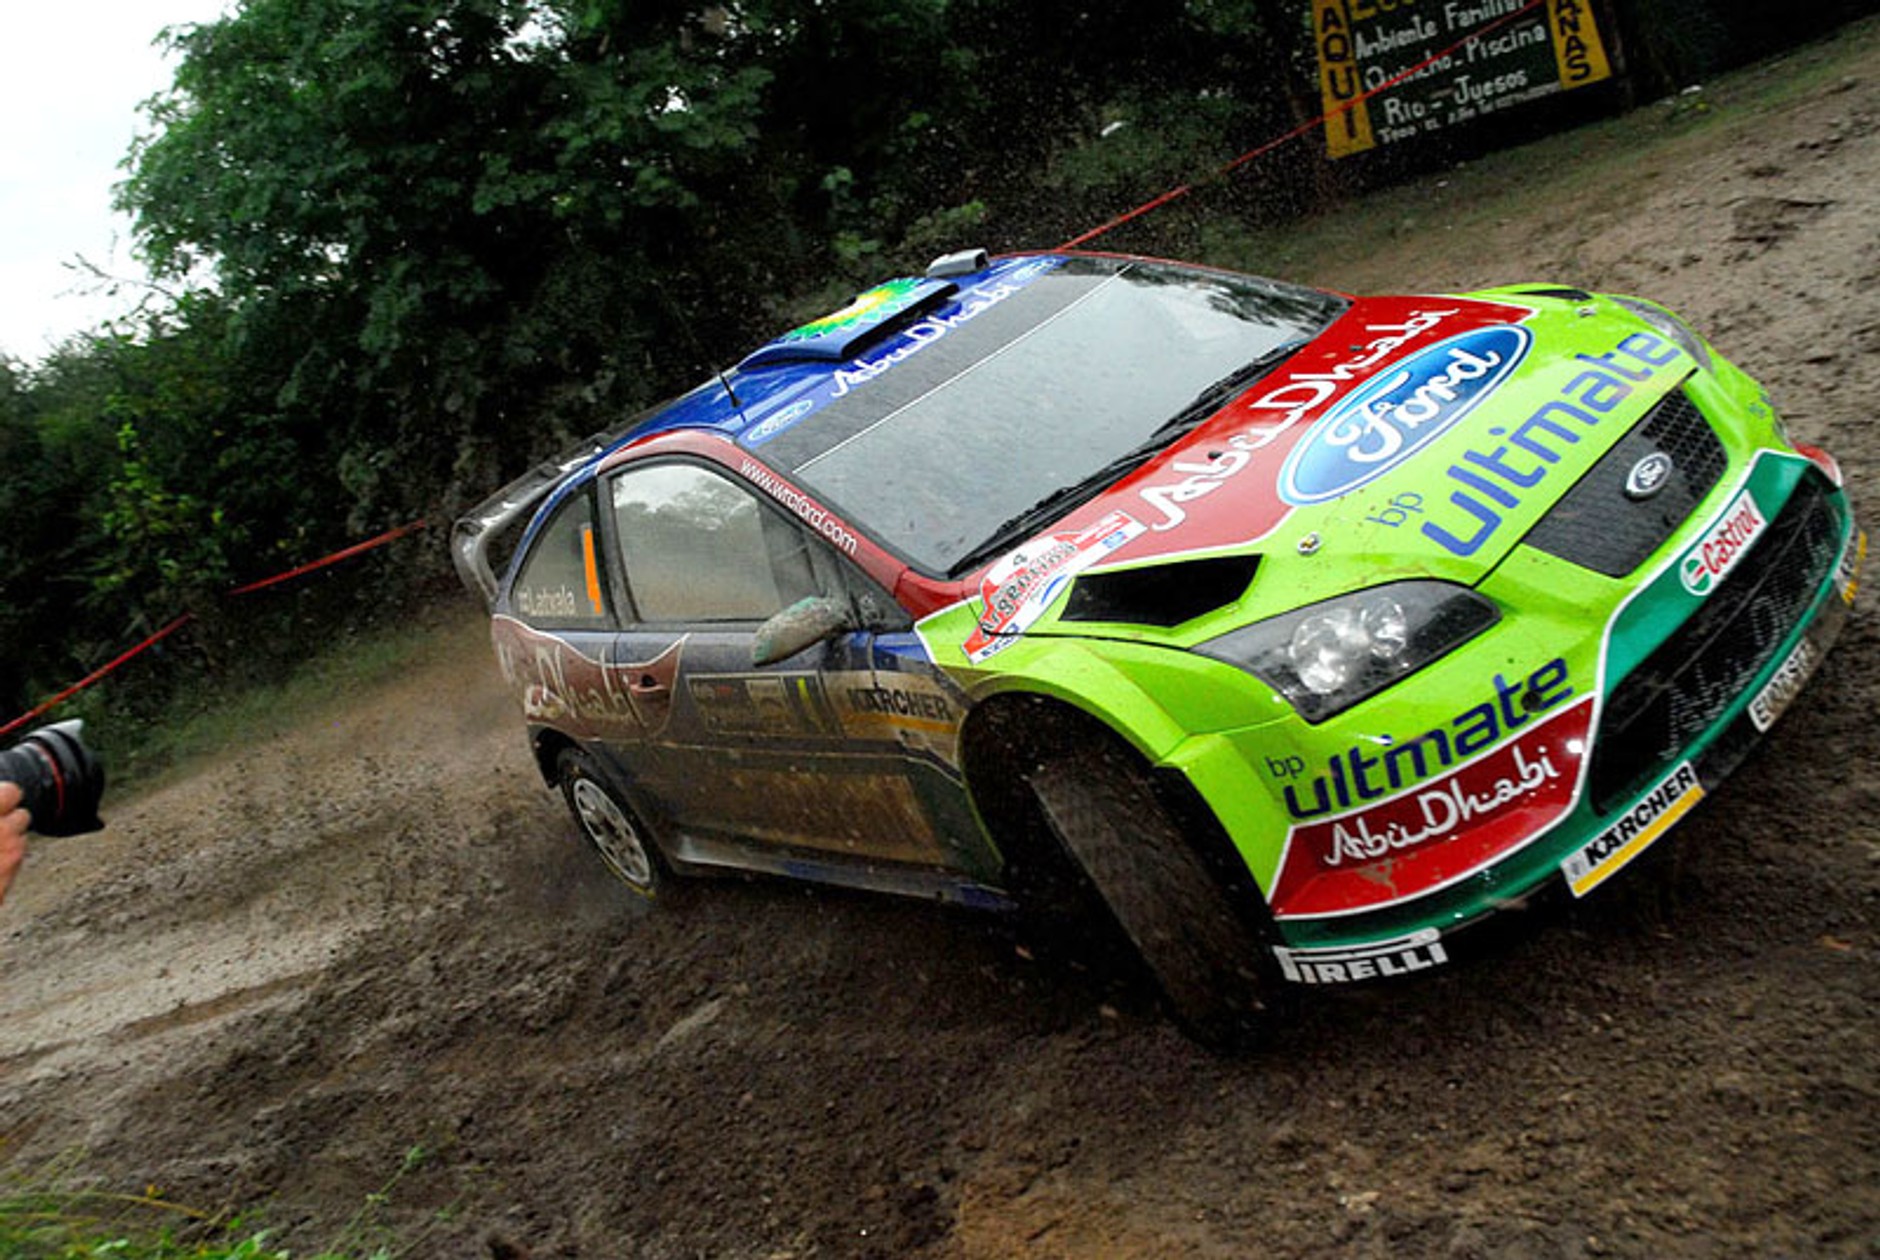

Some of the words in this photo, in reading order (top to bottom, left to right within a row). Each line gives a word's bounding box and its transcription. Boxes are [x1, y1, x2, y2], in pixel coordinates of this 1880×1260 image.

[1320, 7, 1358, 139] AQUI
[1466, 25, 1546, 62] Piscina
[831, 344, 913, 397] Abu
[904, 281, 1022, 352] Dhabi
[1138, 405, 1292, 532] Abu
[1250, 307, 1461, 428] Dhabi
[1325, 347, 1502, 464] Ford
[1366, 491, 1423, 528] bp
[1420, 331, 1682, 558] ultimate
[740, 459, 857, 556] www.wrcford.com
[1703, 500, 1760, 575] Castrol
[981, 543, 1077, 642] Argentina
[1265, 755, 1305, 780] bp
[1282, 657, 1574, 819] ultimate
[1323, 816, 1424, 867] Abu
[1415, 745, 1561, 836] Dhabi
[1270, 927, 1449, 985] PIRELLI
